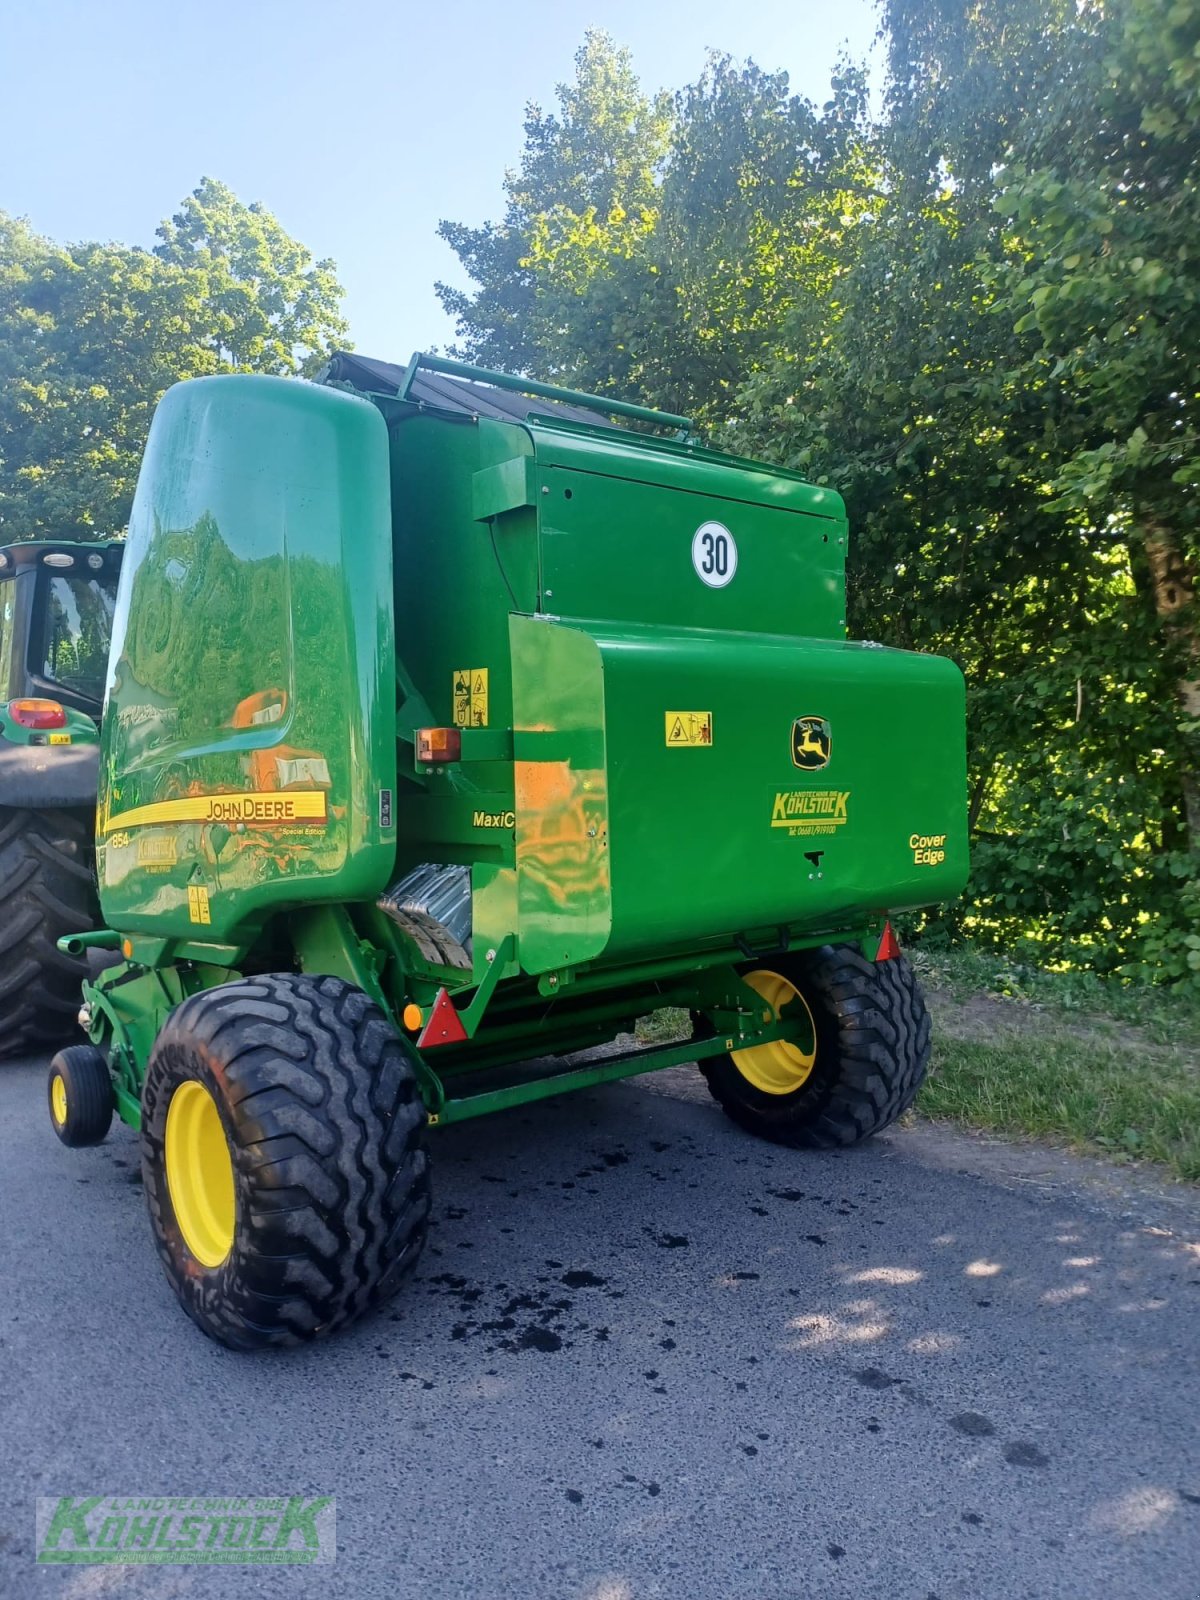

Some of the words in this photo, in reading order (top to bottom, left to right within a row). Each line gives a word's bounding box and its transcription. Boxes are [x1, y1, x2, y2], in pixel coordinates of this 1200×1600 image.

[702, 533, 728, 576] 30
[206, 800, 241, 819] JOHN
[243, 799, 294, 818] DEERE
[772, 792, 851, 820] KOHLSTOCK
[113, 832, 128, 848] 854
[282, 828, 303, 836] Special
[304, 828, 326, 836] Edition
[909, 834, 946, 849] Cover
[914, 849, 945, 865] Edge
